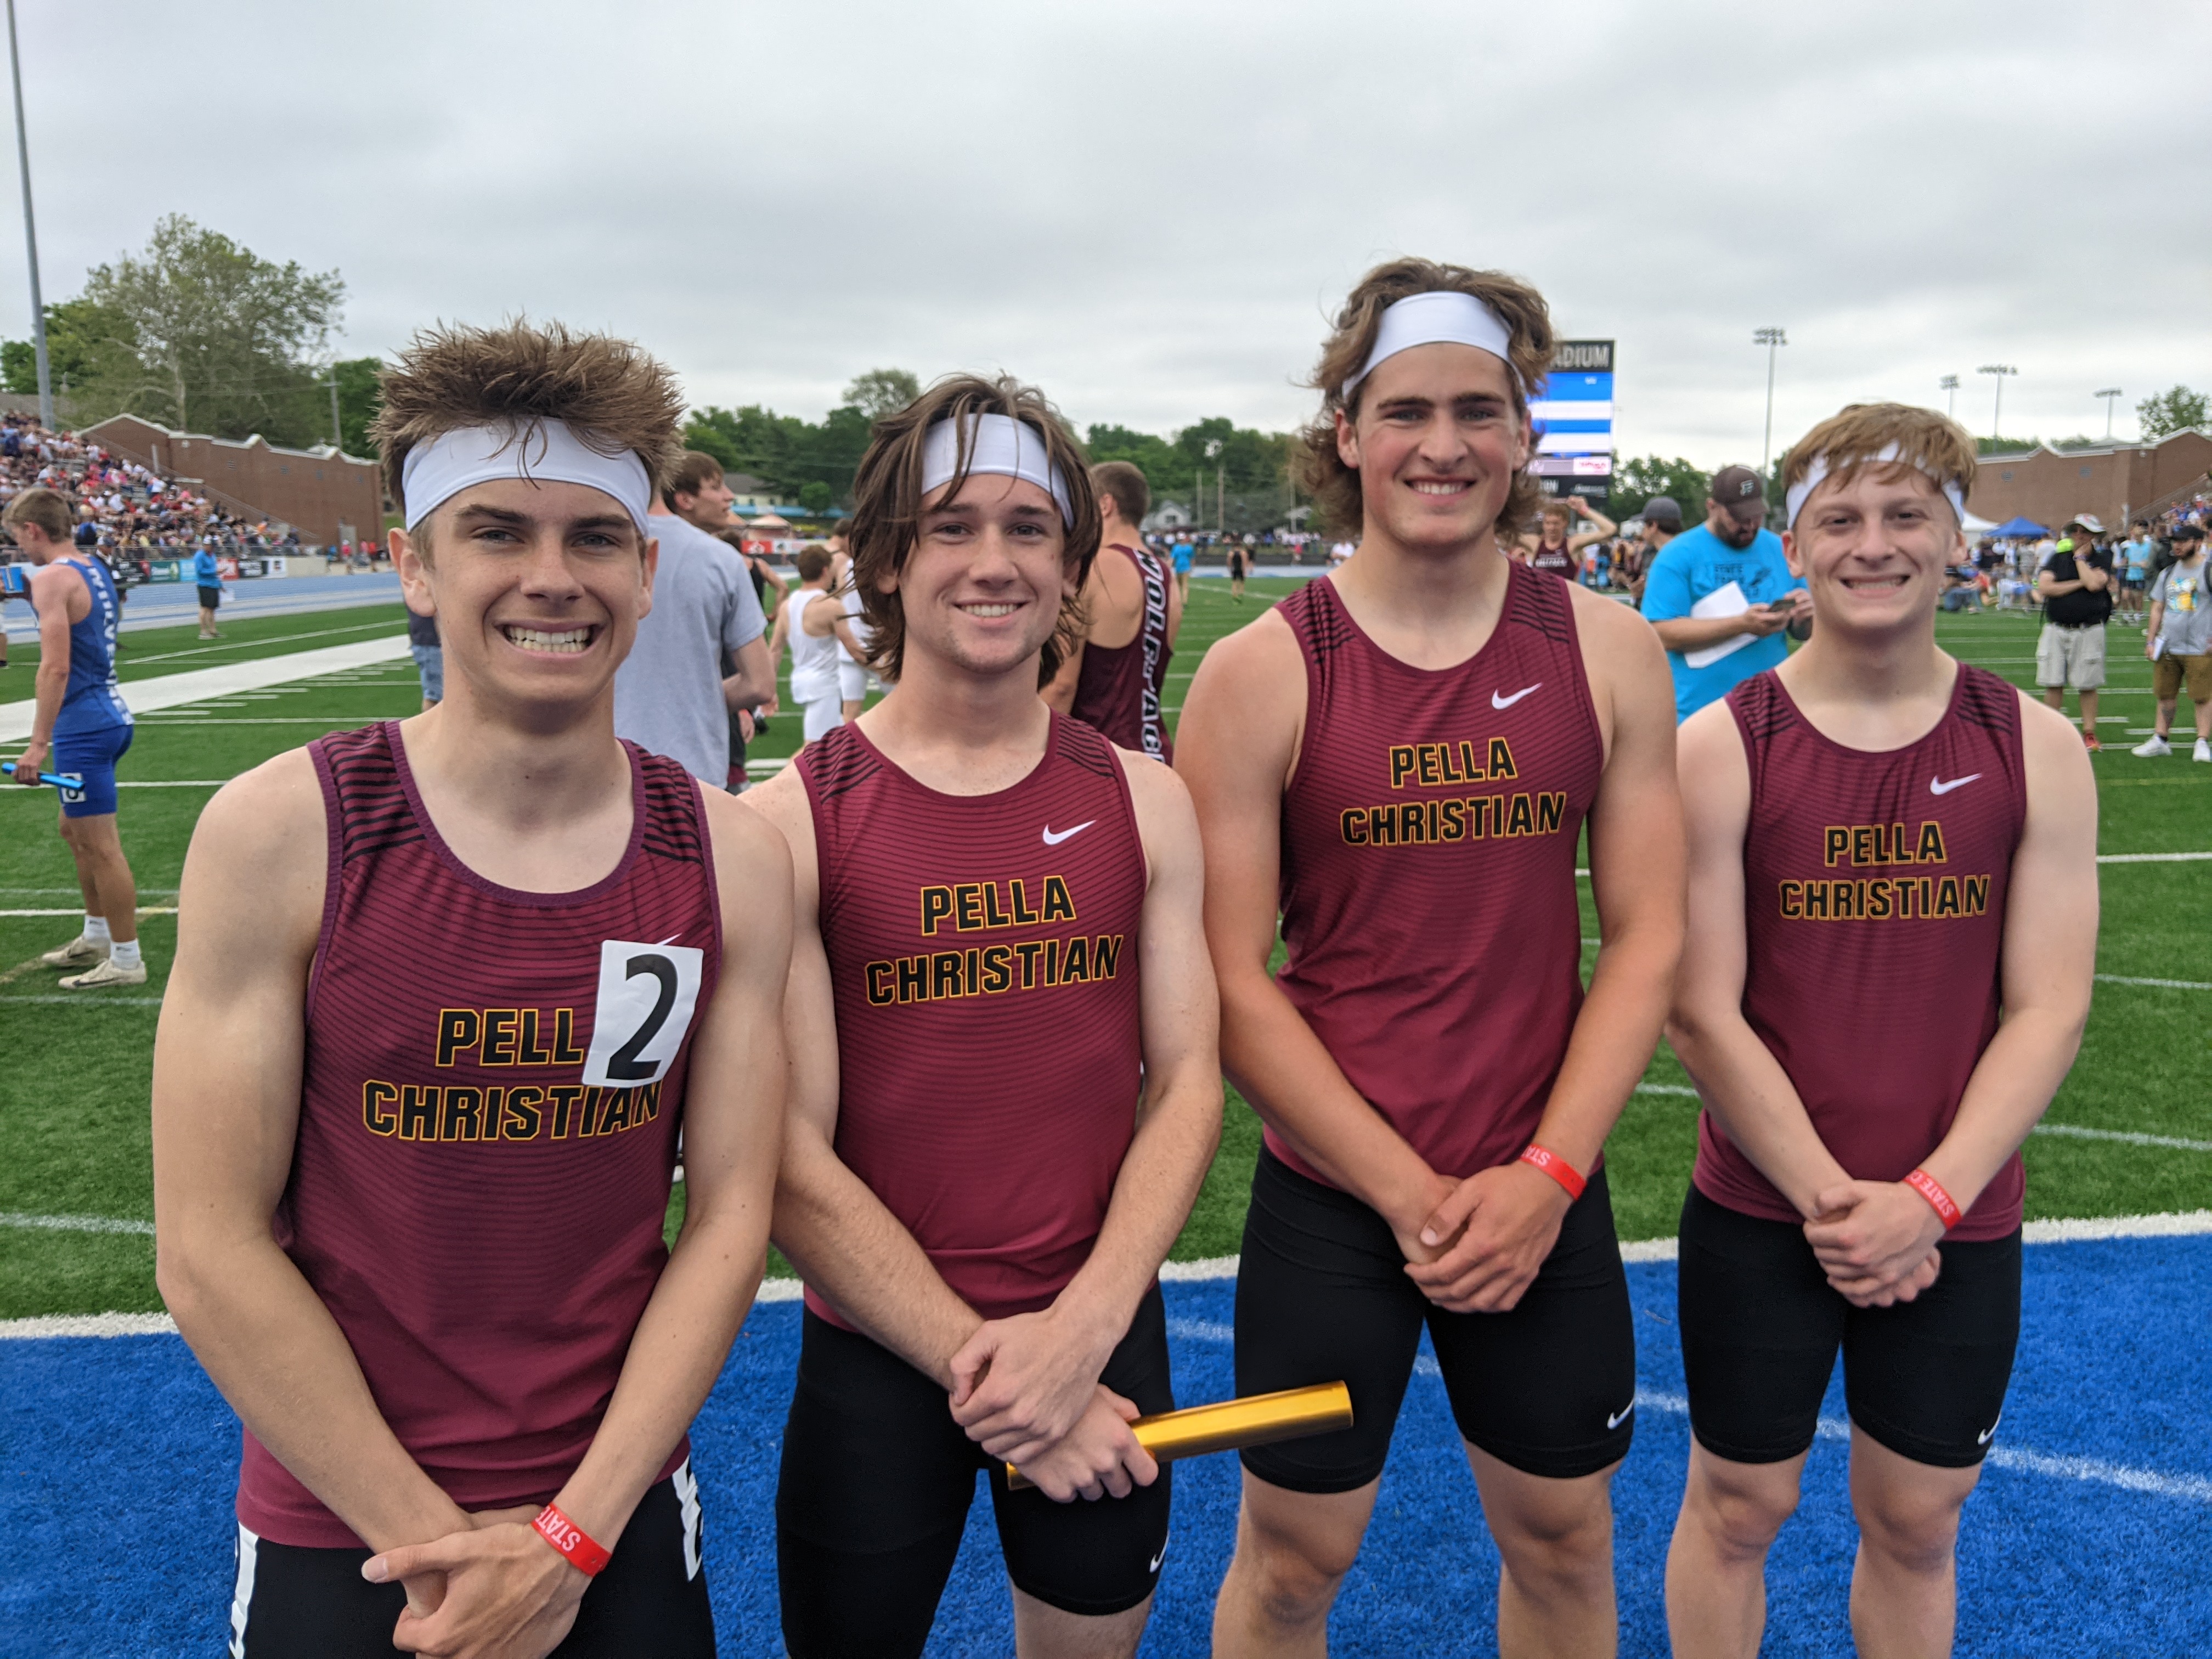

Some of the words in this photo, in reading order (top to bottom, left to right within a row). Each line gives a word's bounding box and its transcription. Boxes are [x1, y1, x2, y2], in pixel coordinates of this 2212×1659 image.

[1549, 344, 1610, 368] ADIUM
[1389, 736, 1519, 790] PELLA
[1340, 791, 1567, 848] CHRISTIAN
[1824, 820, 1948, 868] PELLA
[920, 874, 1077, 937] PELLA
[1778, 873, 1991, 921] CHRISTIAN
[864, 934, 1125, 1007] CHRISTIAN
[435, 1008, 584, 1067] PELL
[606, 953, 679, 1081] 2
[363, 1078, 664, 1142] CHRISTIAN
